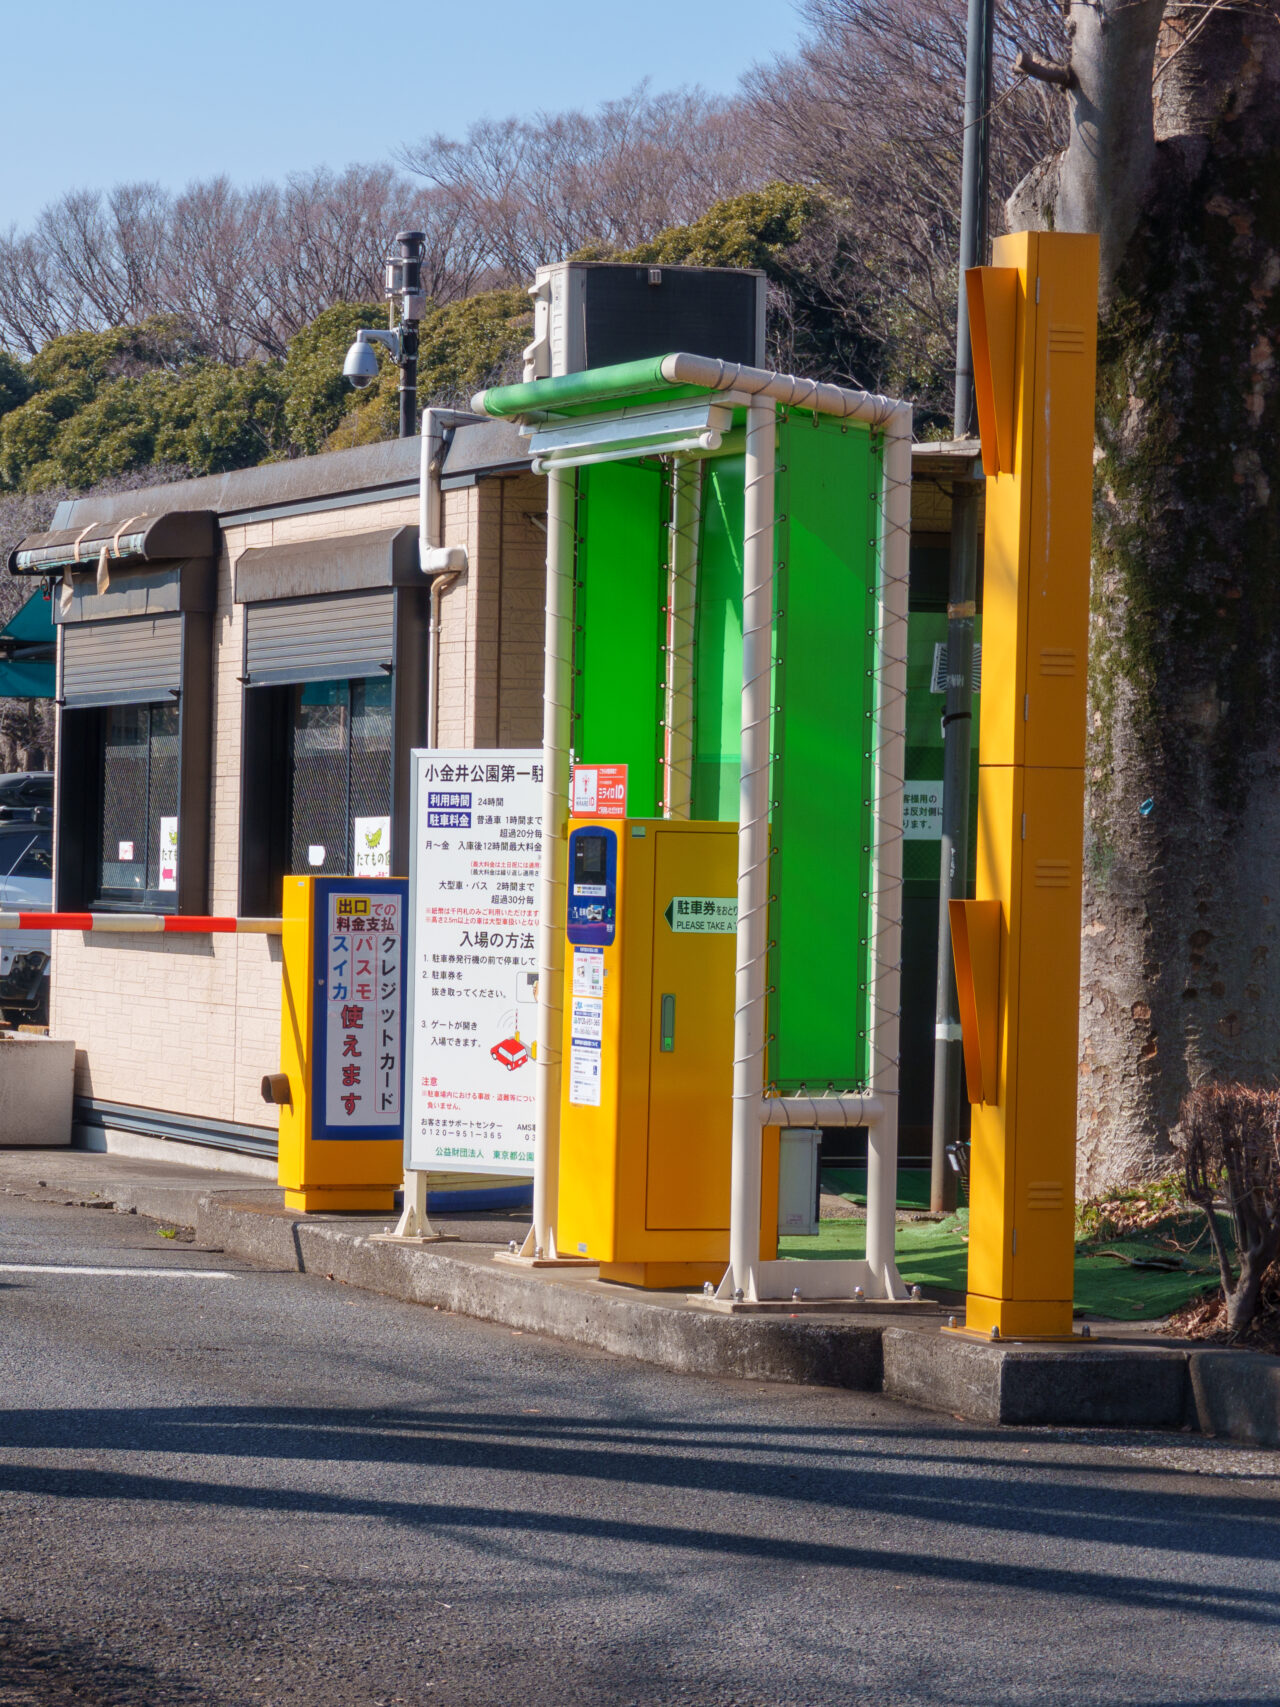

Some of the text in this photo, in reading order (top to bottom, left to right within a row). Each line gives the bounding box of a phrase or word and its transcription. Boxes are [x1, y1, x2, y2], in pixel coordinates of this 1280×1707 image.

[425, 764, 574, 783] 小金井公園第一駐
[430, 793, 504, 807] 利用時間 24時間
[429, 813, 543, 828] 駐車料金 普通車 1時間まで
[499, 829, 543, 839] 超過20分毎
[458, 841, 543, 852] 入庫後12時間最大料金
[439, 880, 535, 891] 大型車・バス 2時間まで
[491, 894, 534, 905] 超過30分毎
[338, 898, 397, 916] 出口での
[336, 917, 395, 932] 料金支払
[676, 921, 705, 930] PLEASE
[707, 921, 725, 930] TAKE
[726, 921, 733, 931] A
[460, 930, 535, 949] 入場の方法
[432, 954, 536, 966] 駐車券発行機の前で停車して
[332, 936, 349, 1000] スイカ
[356, 936, 372, 1000] パスモ
[432, 971, 463, 980] 駐車券を
[431, 987, 506, 999] 抜き取ってください。
[380, 936, 397, 1111] クレジットカード
[431, 1020, 478, 1031] ゲートが開き
[431, 1036, 482, 1048] 入場できます。
[341, 1005, 364, 1115] 使えます
[421, 1077, 438, 1087] 注意
[426, 1101, 461, 1111] 負いません。
[421, 1118, 503, 1130] お客さまサポートセンター
[435, 1147, 535, 1161] 公益財団法人 東京都公園
